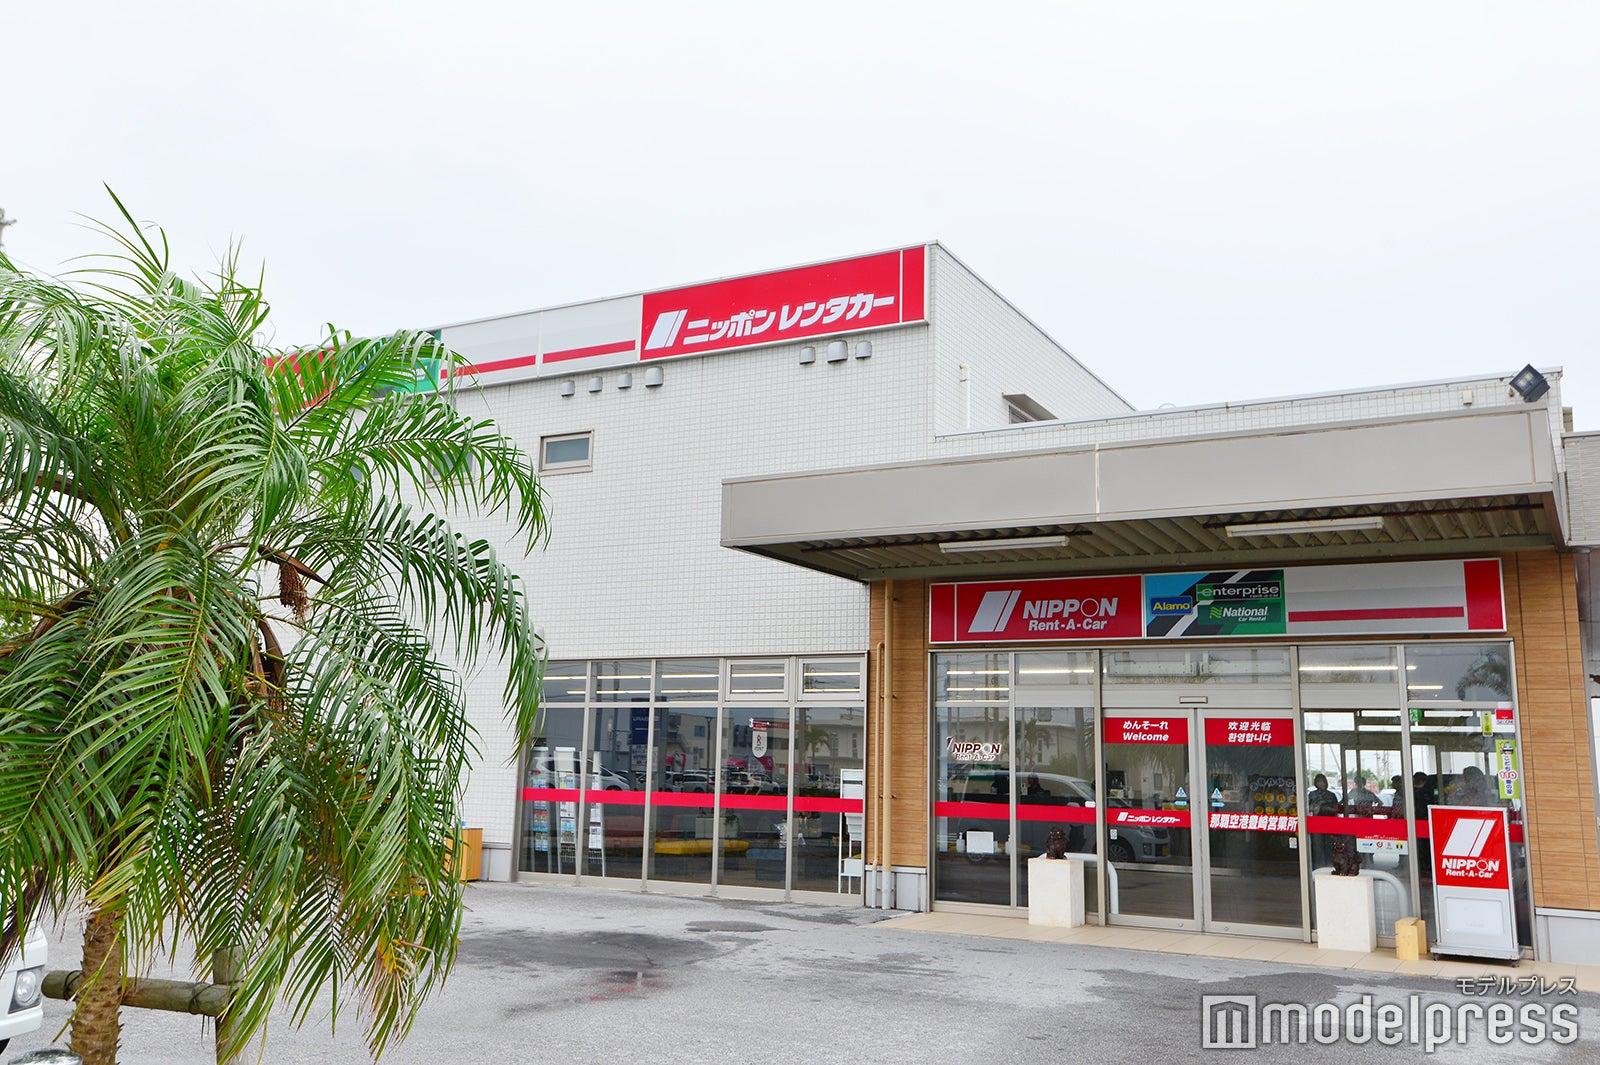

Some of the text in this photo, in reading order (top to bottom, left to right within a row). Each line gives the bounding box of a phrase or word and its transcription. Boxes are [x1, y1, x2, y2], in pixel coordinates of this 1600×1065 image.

[684, 293, 895, 345] ニッポンレンタカー
[1201, 584, 1279, 597] enterprise
[1023, 597, 1118, 619] NIPPON
[1153, 602, 1191, 611] Alamo
[1222, 606, 1269, 617] National
[1122, 720, 1169, 730] めんそーれ
[1228, 721, 1271, 731] 欢迎光临
[1123, 732, 1169, 741] Welcome
[952, 742, 1001, 755] NIPPON
[1441, 858, 1500, 872] NIPPON
